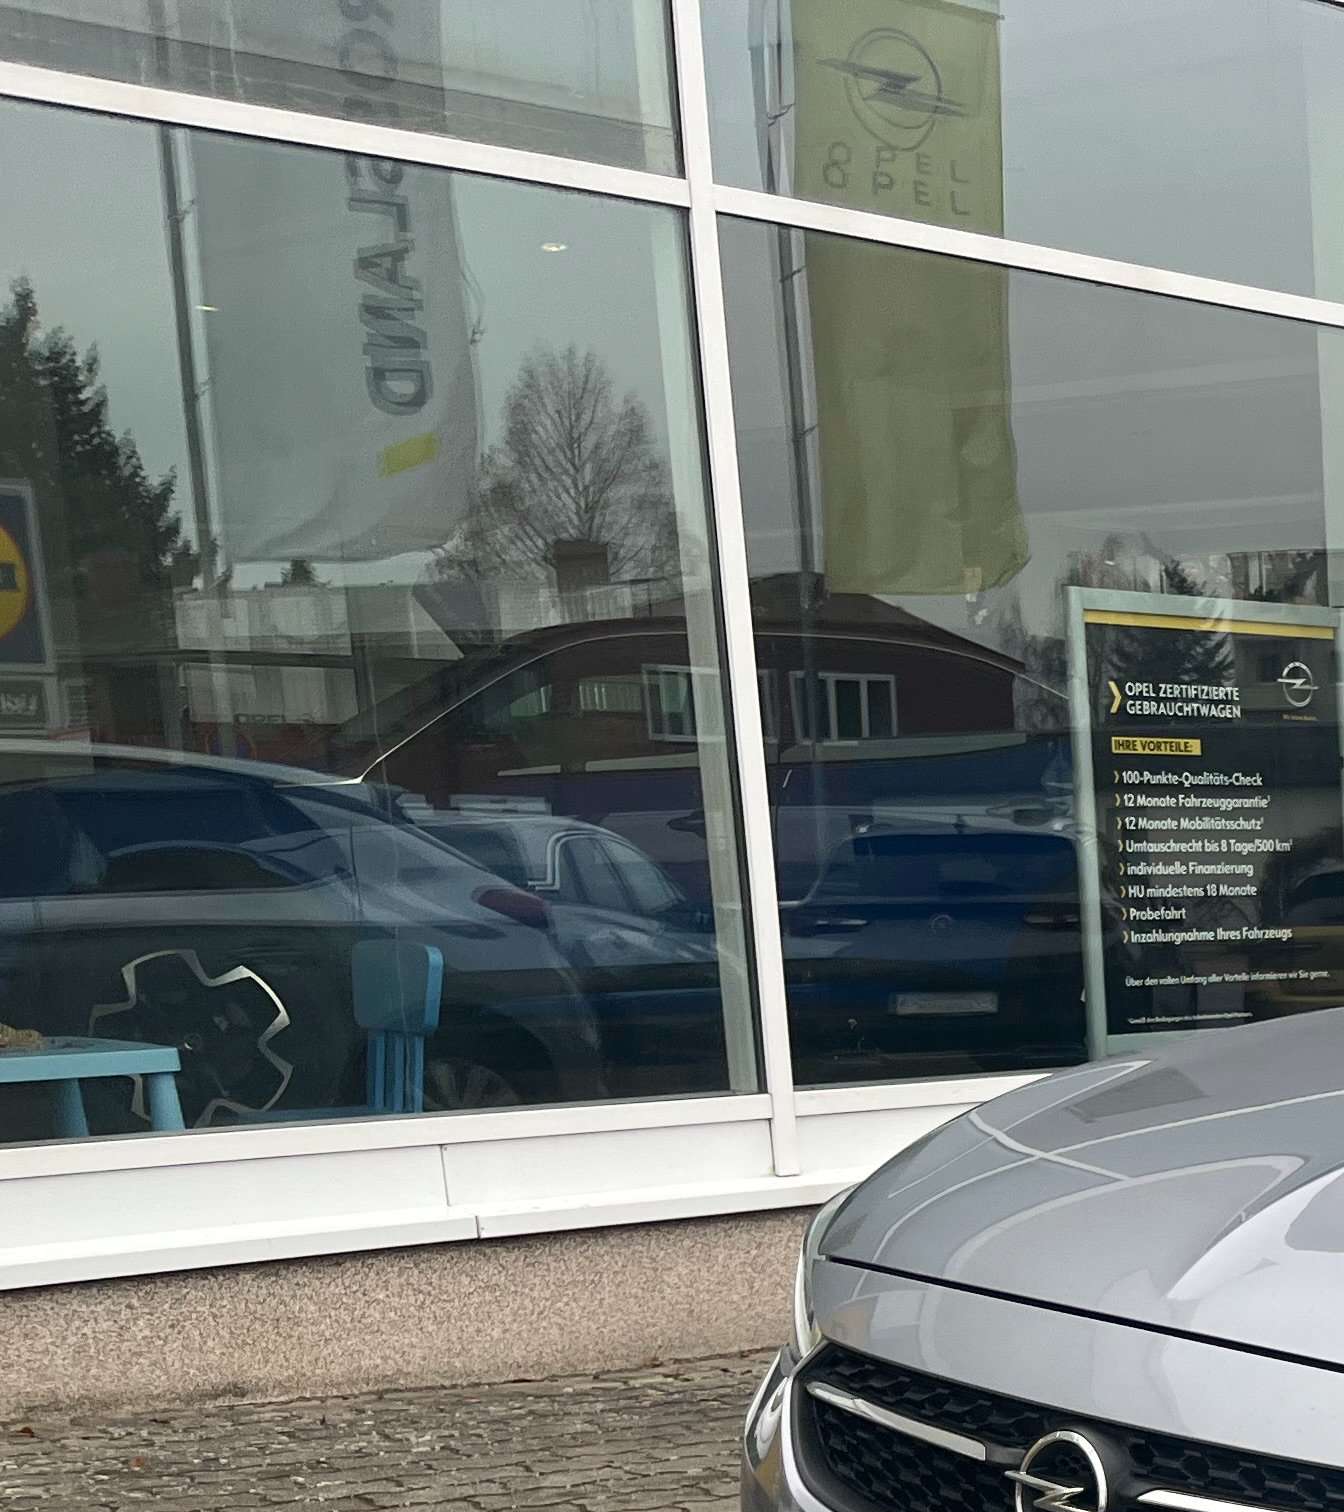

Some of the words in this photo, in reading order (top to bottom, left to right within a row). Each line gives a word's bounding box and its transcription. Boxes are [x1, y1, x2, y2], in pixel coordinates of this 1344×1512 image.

[1125, 682, 1156, 697] OPEL
[1159, 684, 1240, 701] ZERTIFIZIERTE
[1126, 701, 1241, 718] GEBRAUCHTWAGEN
[1114, 739, 1137, 751] IHRE
[1140, 740, 1193, 753] VORTEILE:
[1122, 771, 1263, 787] 100-Punkte-Qualitäts-Check
[1123, 794, 1136, 807] 12
[1137, 795, 1176, 808] Monate
[1124, 817, 1136, 829] 12
[1138, 817, 1178, 830] Monate
[1125, 840, 1203, 853] Umtauschrecht
[1205, 840, 1220, 852] bis
[1221, 840, 1228, 852] 8
[1229, 840, 1274, 855] Tage/500
[1127, 861, 1187, 875] individuelle
[1189, 862, 1254, 877] Finanzierung
[1128, 885, 1145, 898] HU
[1146, 885, 1204, 897] mindestens
[1206, 885, 1217, 896] 18
[1219, 884, 1257, 896] Monate
[1129, 906, 1186, 921] Probefahrt
[1130, 929, 1215, 945] Inzahlungnahme
[1217, 928, 1241, 940] Ihres
[1242, 926, 1293, 940] Fahrzeugs
